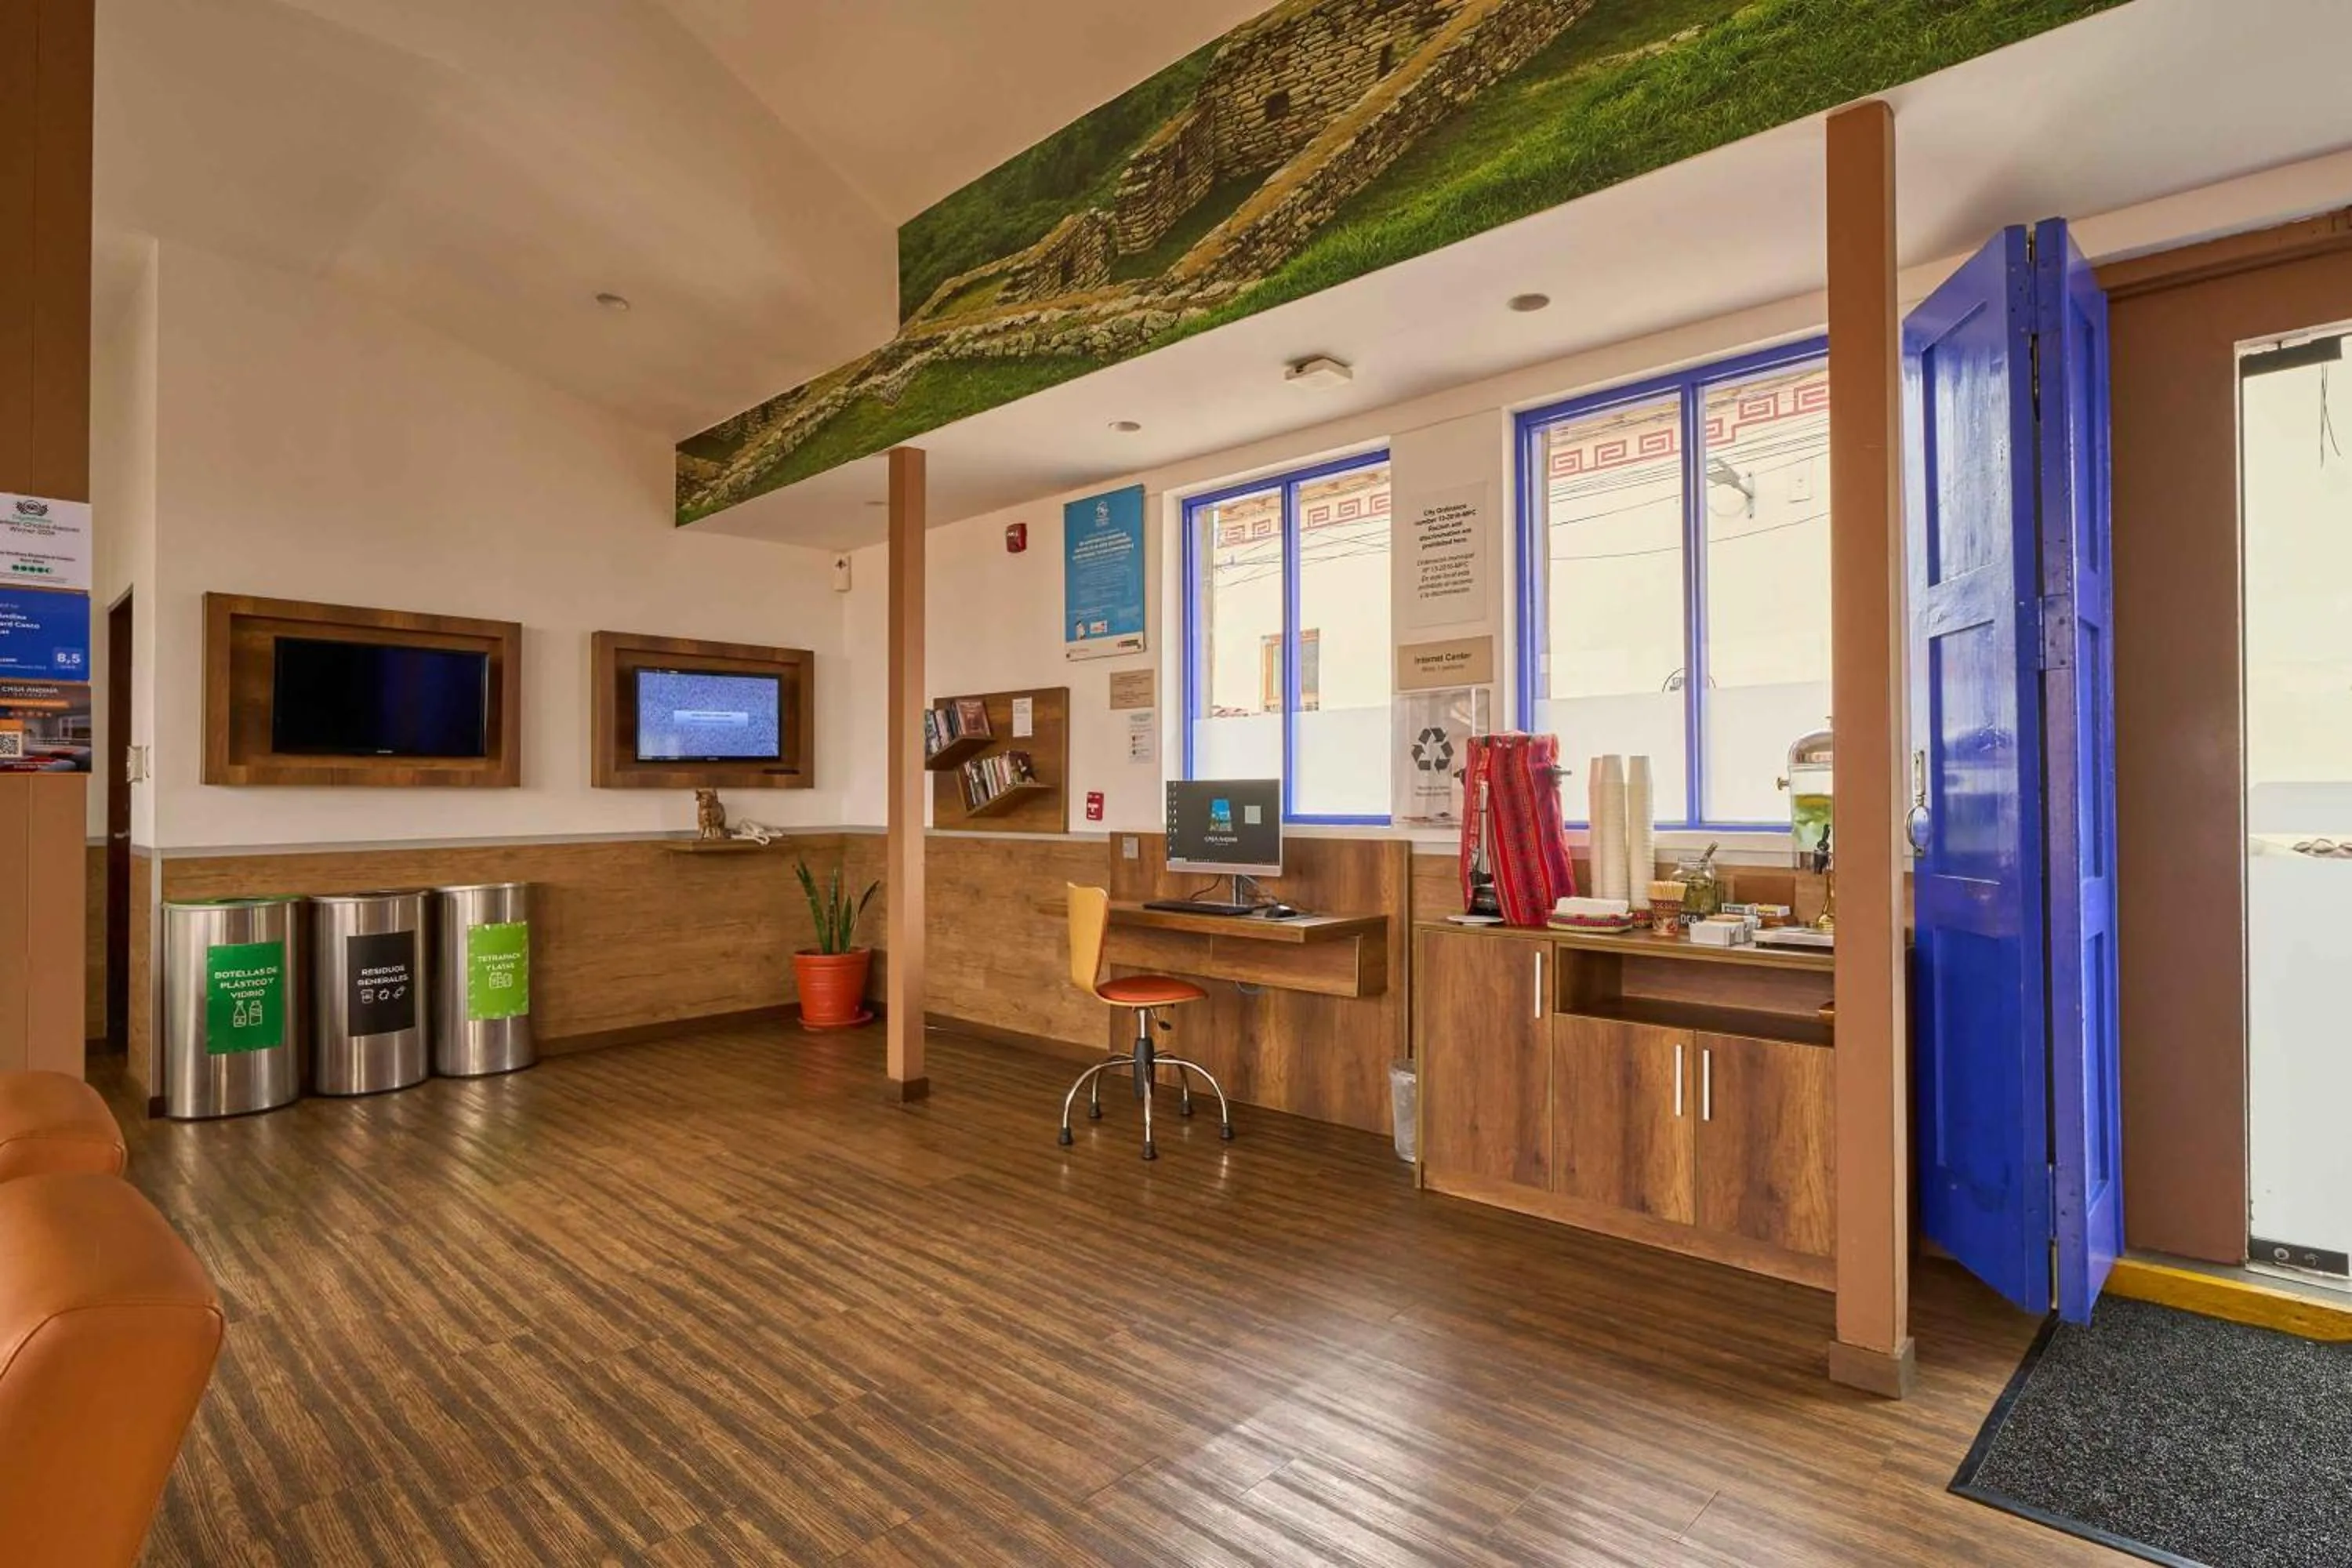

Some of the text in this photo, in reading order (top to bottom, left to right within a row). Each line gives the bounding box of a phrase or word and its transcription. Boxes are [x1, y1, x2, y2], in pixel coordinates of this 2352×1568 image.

[1414, 652, 1472, 665] Internet Center
[214, 967, 265, 979] BOTELLAS
[361, 964, 405, 976] RESIDUOS
[357, 974, 409, 985] GENERALES
[230, 989, 265, 998] VIDRIO
